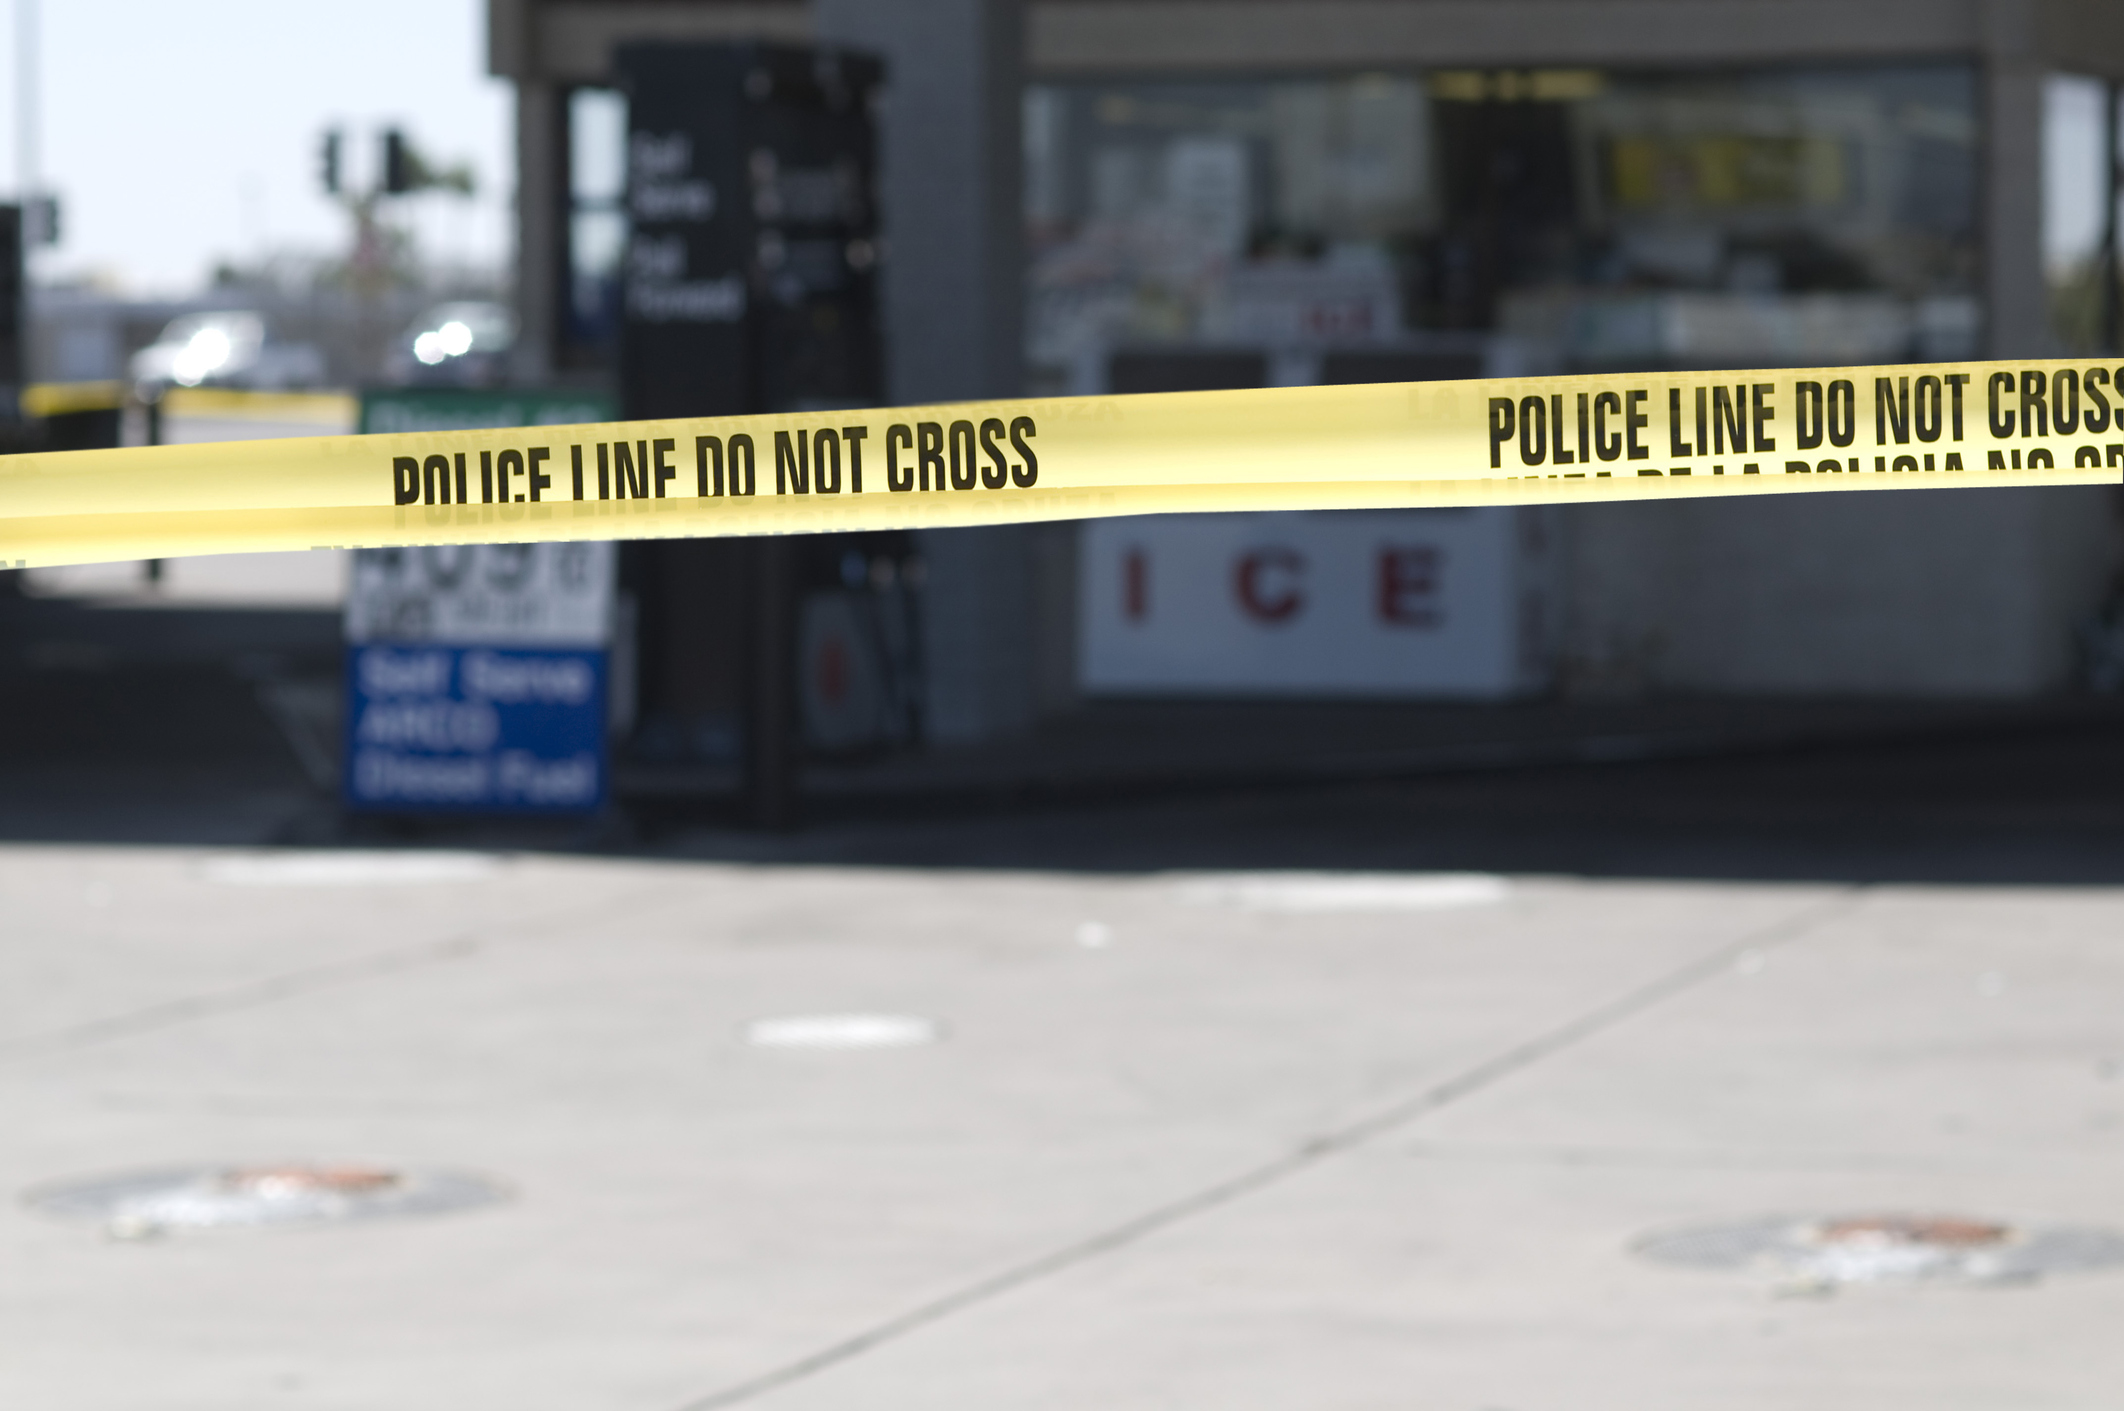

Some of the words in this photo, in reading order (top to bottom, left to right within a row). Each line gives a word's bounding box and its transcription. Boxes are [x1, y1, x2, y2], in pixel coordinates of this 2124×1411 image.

[393, 447, 551, 510] POLICE
[570, 438, 677, 504] LINE
[695, 433, 756, 499] DO
[773, 425, 869, 496] NOT
[886, 415, 1039, 493] CROSS
[1488, 389, 1650, 469] POLICE
[1668, 382, 1776, 458] LINE
[1795, 379, 1856, 450] DO
[1875, 373, 1971, 446] NOT
[1121, 542, 1447, 630] ICE
[361, 652, 449, 695] Self
[461, 653, 592, 701] Serve
